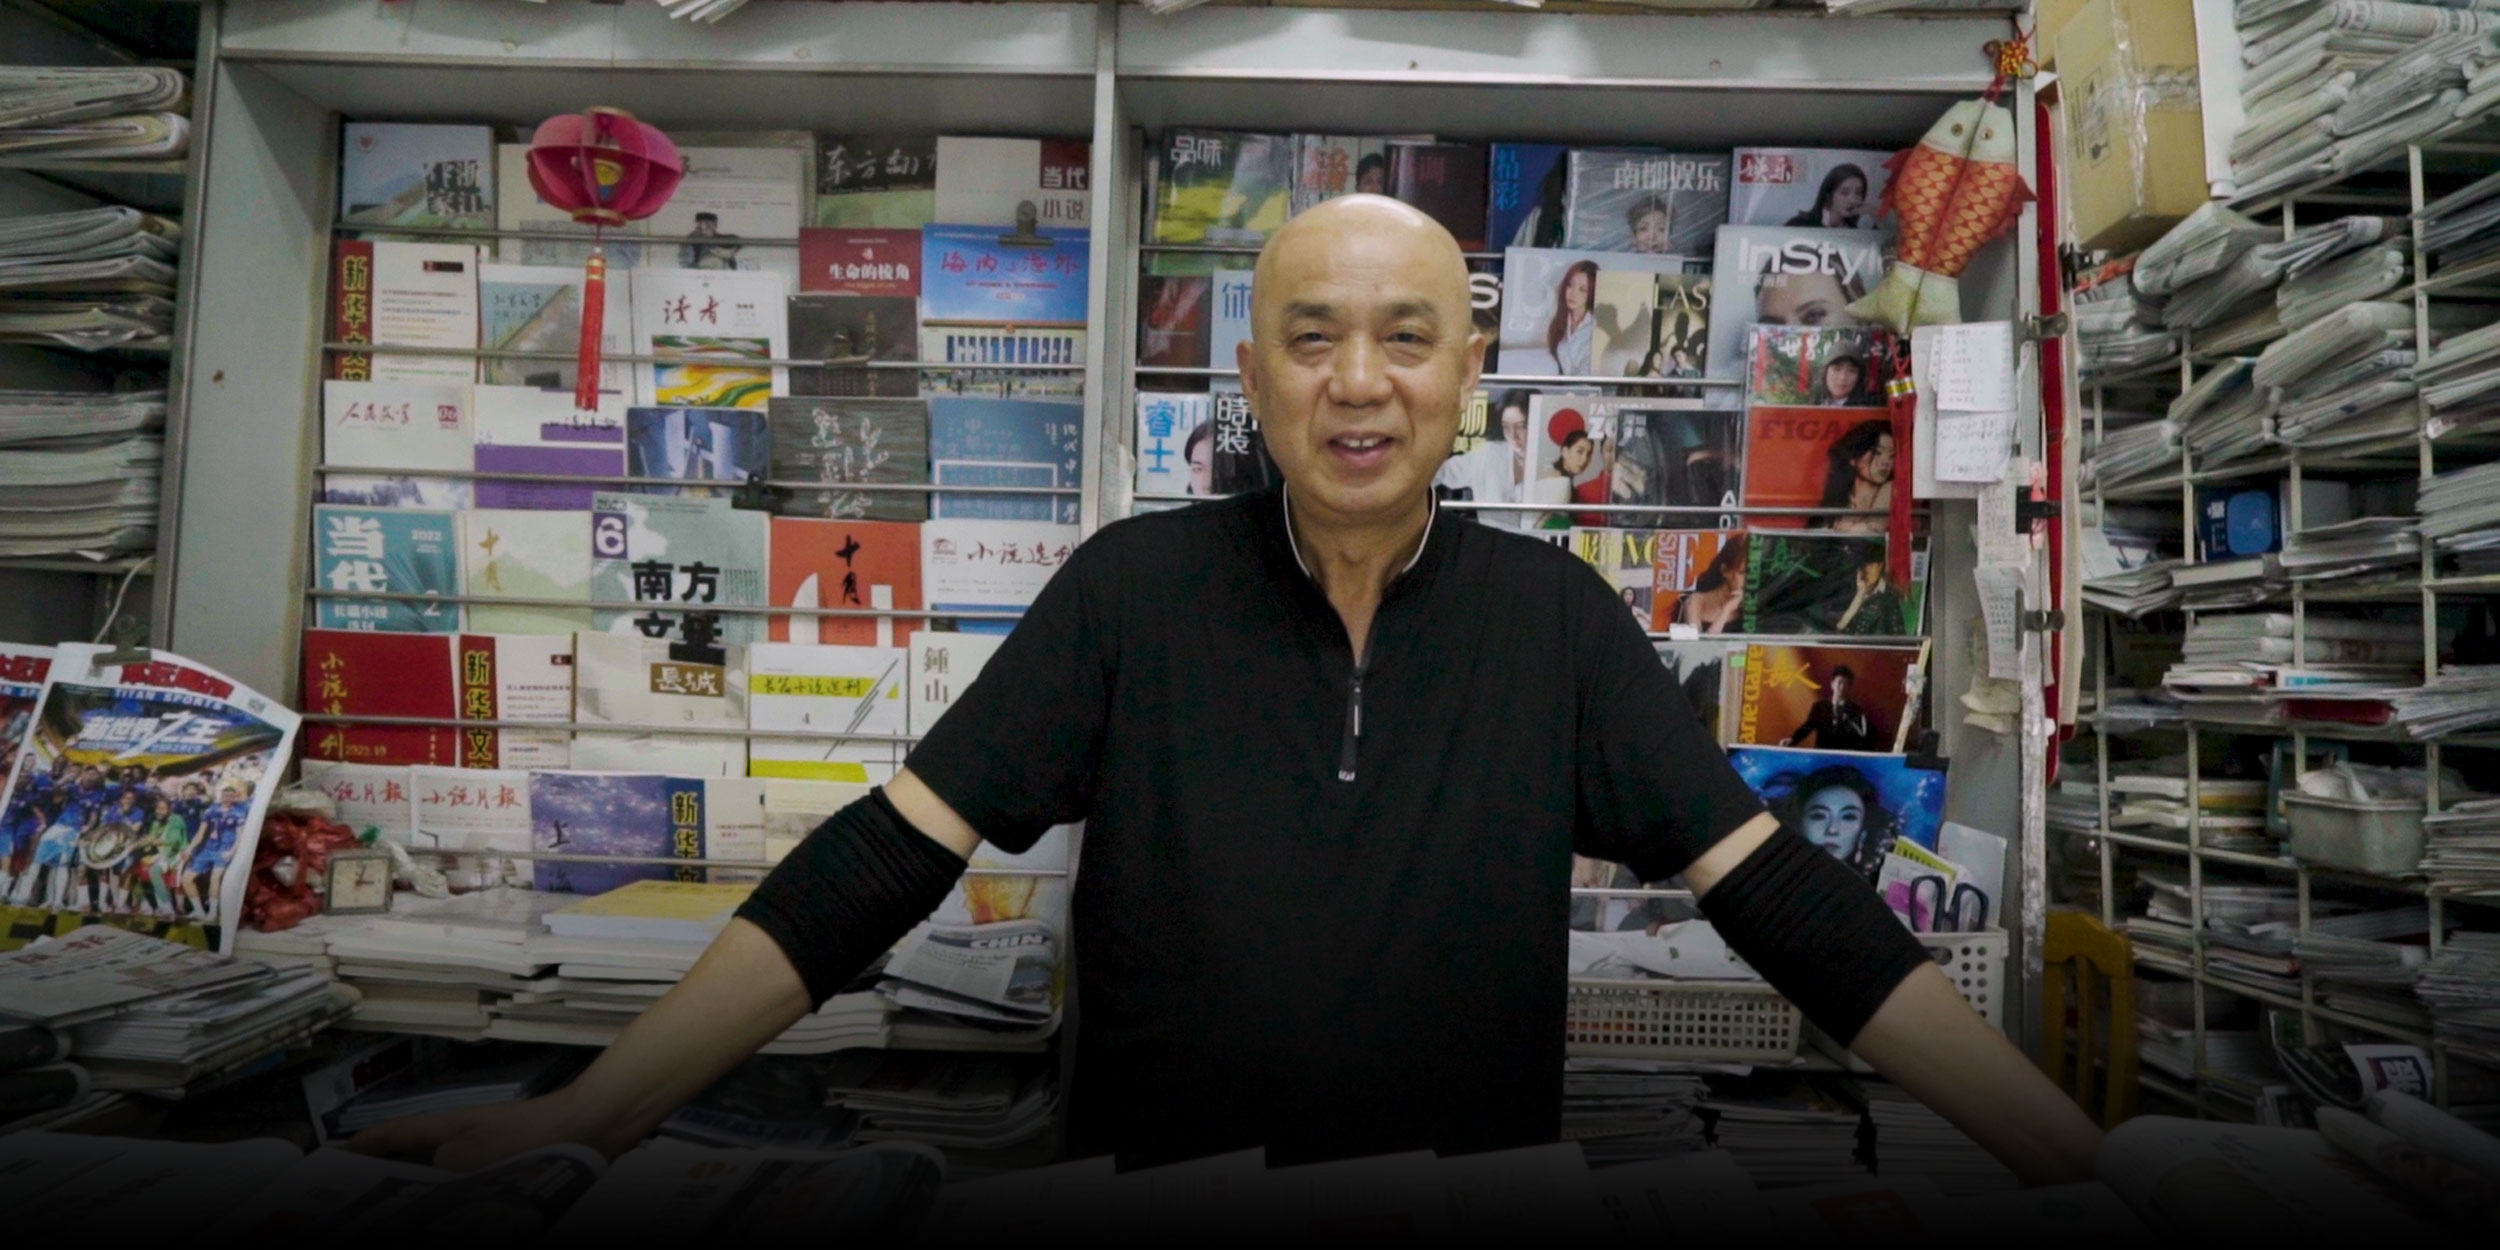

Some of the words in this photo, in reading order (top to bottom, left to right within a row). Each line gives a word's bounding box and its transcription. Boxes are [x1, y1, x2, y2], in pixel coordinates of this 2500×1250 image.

[1170, 135, 1223, 167] 品味
[1044, 166, 1085, 187] 当代
[1613, 159, 1722, 192] 南都娱乐
[1043, 198, 1084, 220] 小说
[829, 263, 910, 280] 生命的棱角
[663, 294, 719, 325] 读者
[338, 402, 410, 425] 人民文学
[1216, 396, 1249, 455] 時装
[1144, 400, 1176, 473] 睿士
[411, 529, 442, 542] 2022
[596, 516, 624, 556] 6
[326, 515, 388, 593] 当代
[834, 533, 862, 606] 十月
[1656, 533, 1677, 592] SUPER
[631, 560, 720, 601] 南方
[655, 666, 718, 695] 長城
[924, 646, 949, 704] 鍾山
[114, 687, 156, 701] TITAN
[162, 692, 224, 711] SPORTS
[465, 650, 492, 768] 新华文
[684, 708, 694, 721] 3
[802, 711, 810, 725] 4
